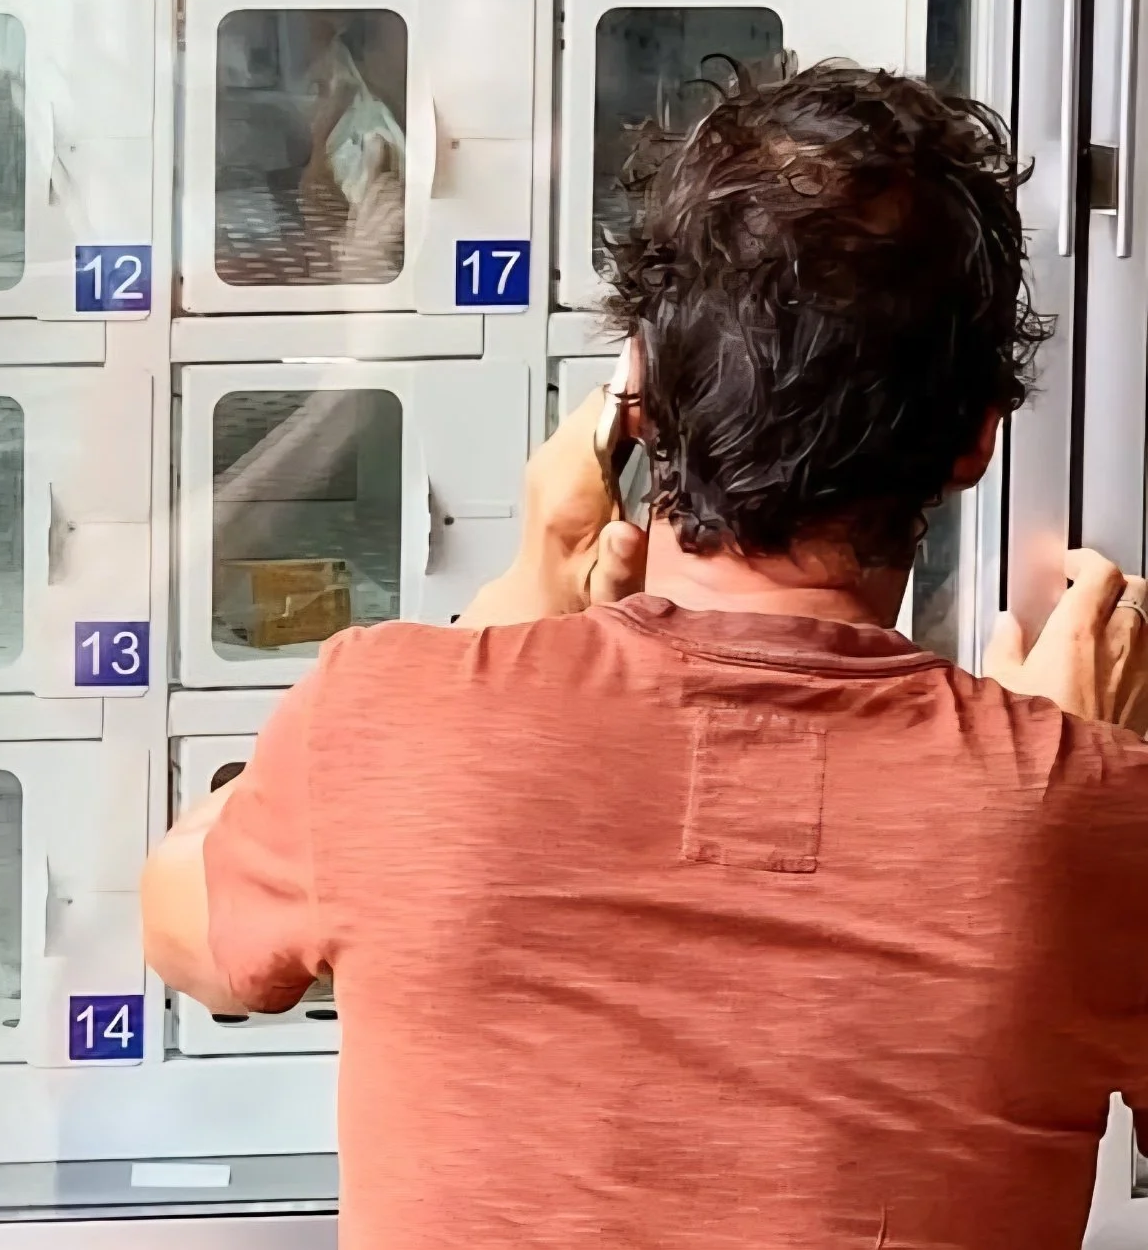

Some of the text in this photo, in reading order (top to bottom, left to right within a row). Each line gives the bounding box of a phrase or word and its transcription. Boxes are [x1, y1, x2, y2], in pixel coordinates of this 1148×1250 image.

[81, 255, 144, 300] 12
[461, 250, 521, 295] 17
[80, 631, 140, 676] 13
[76, 1004, 135, 1048] 14
